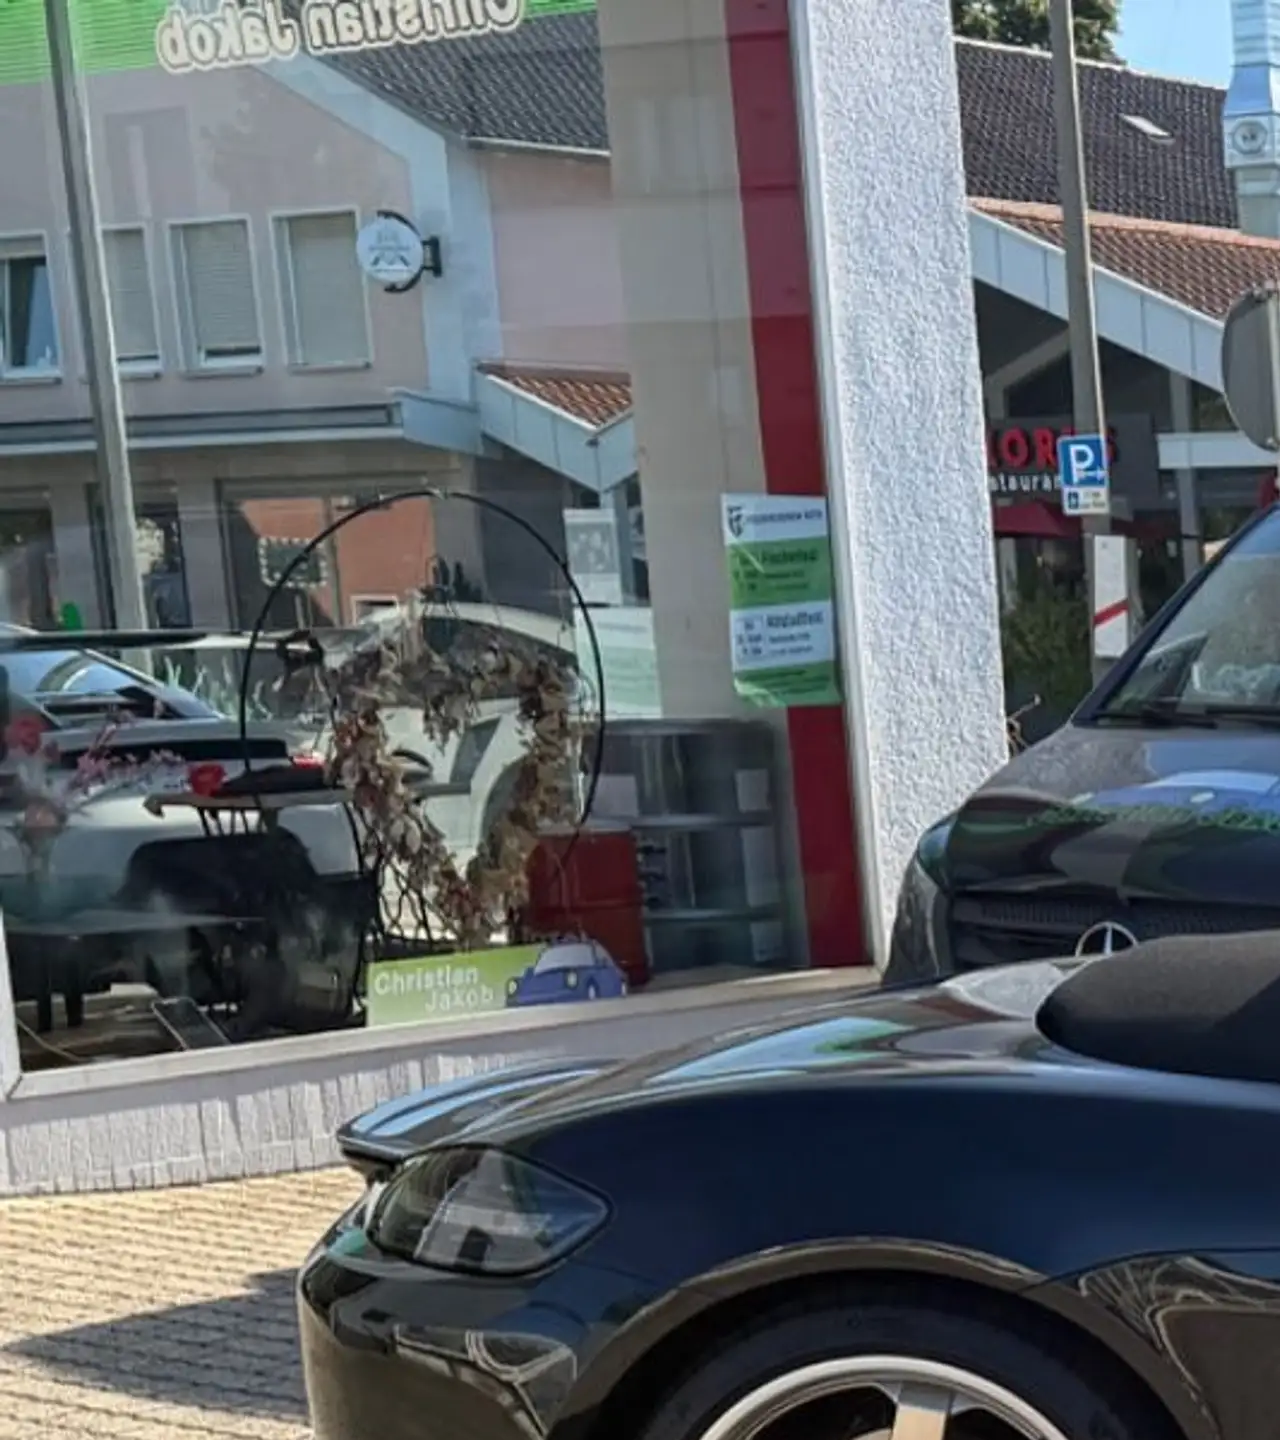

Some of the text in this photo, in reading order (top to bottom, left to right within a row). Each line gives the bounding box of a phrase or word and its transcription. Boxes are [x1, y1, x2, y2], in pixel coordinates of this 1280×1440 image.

[1068, 443, 1095, 484] P
[374, 965, 479, 996] Christian
[425, 984, 494, 1013] Jakob
